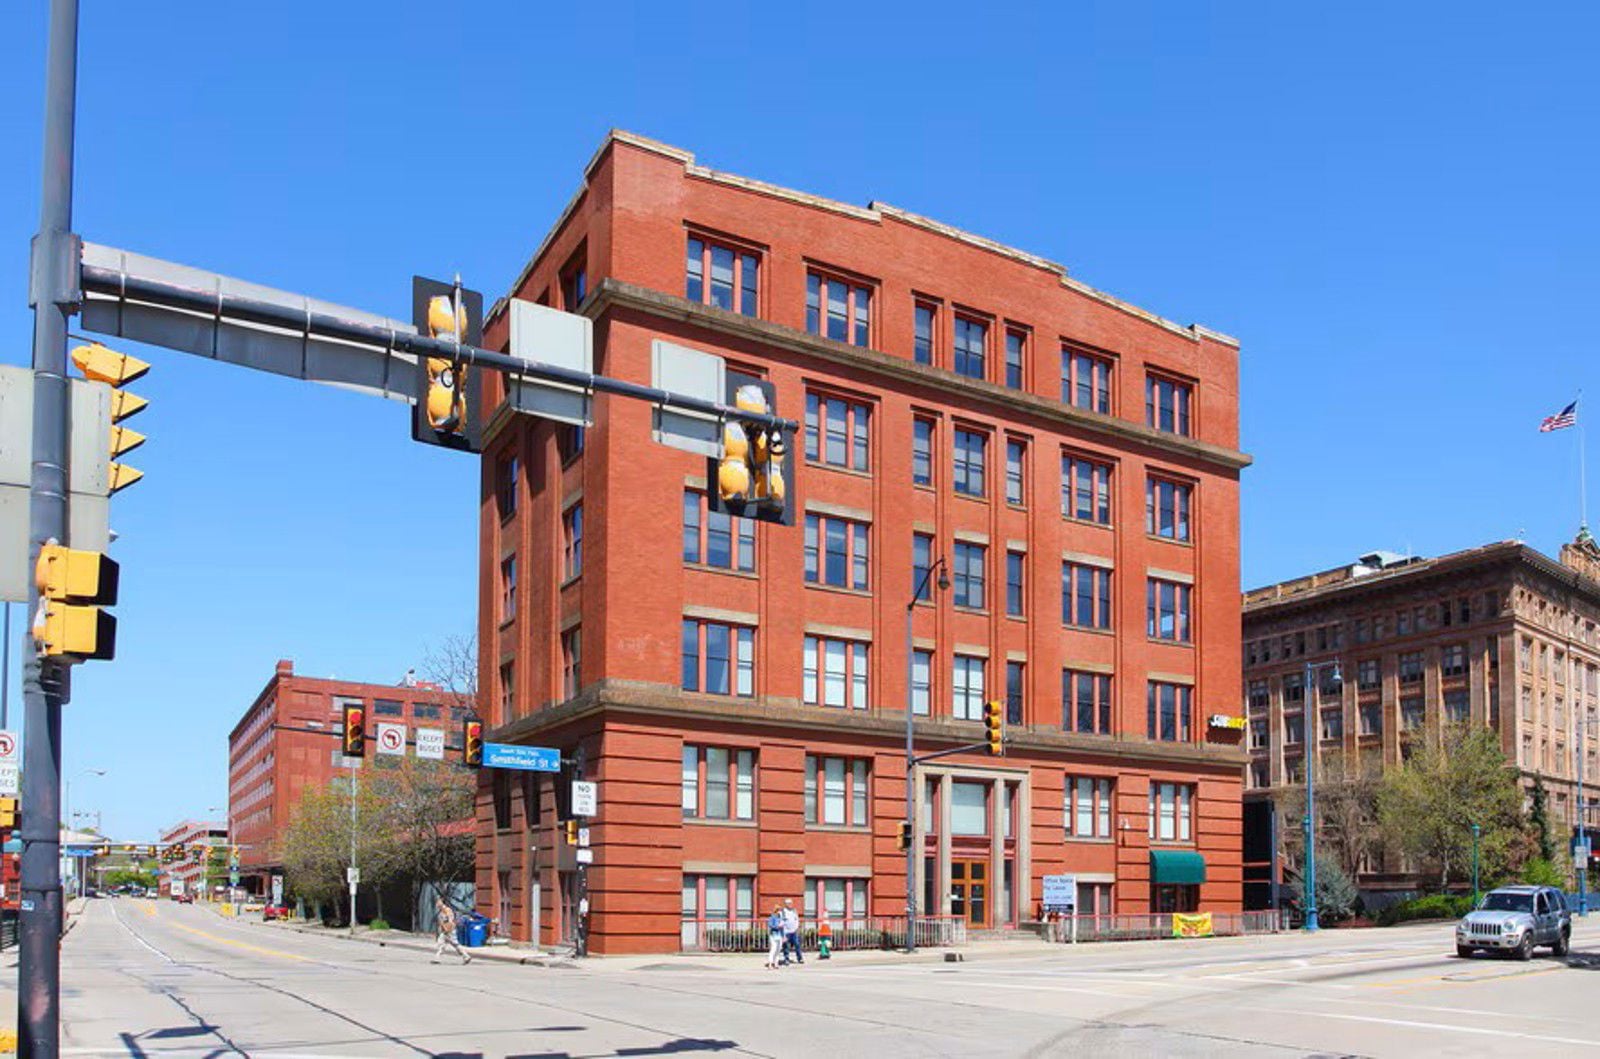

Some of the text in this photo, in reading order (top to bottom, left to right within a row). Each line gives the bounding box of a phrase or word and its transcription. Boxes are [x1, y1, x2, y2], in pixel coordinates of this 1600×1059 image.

[417, 735, 442, 743] EXCEPT
[419, 744, 442, 753] BUSES
[490, 754, 549, 768] Smithfield St
[578, 784, 591, 793] NO
